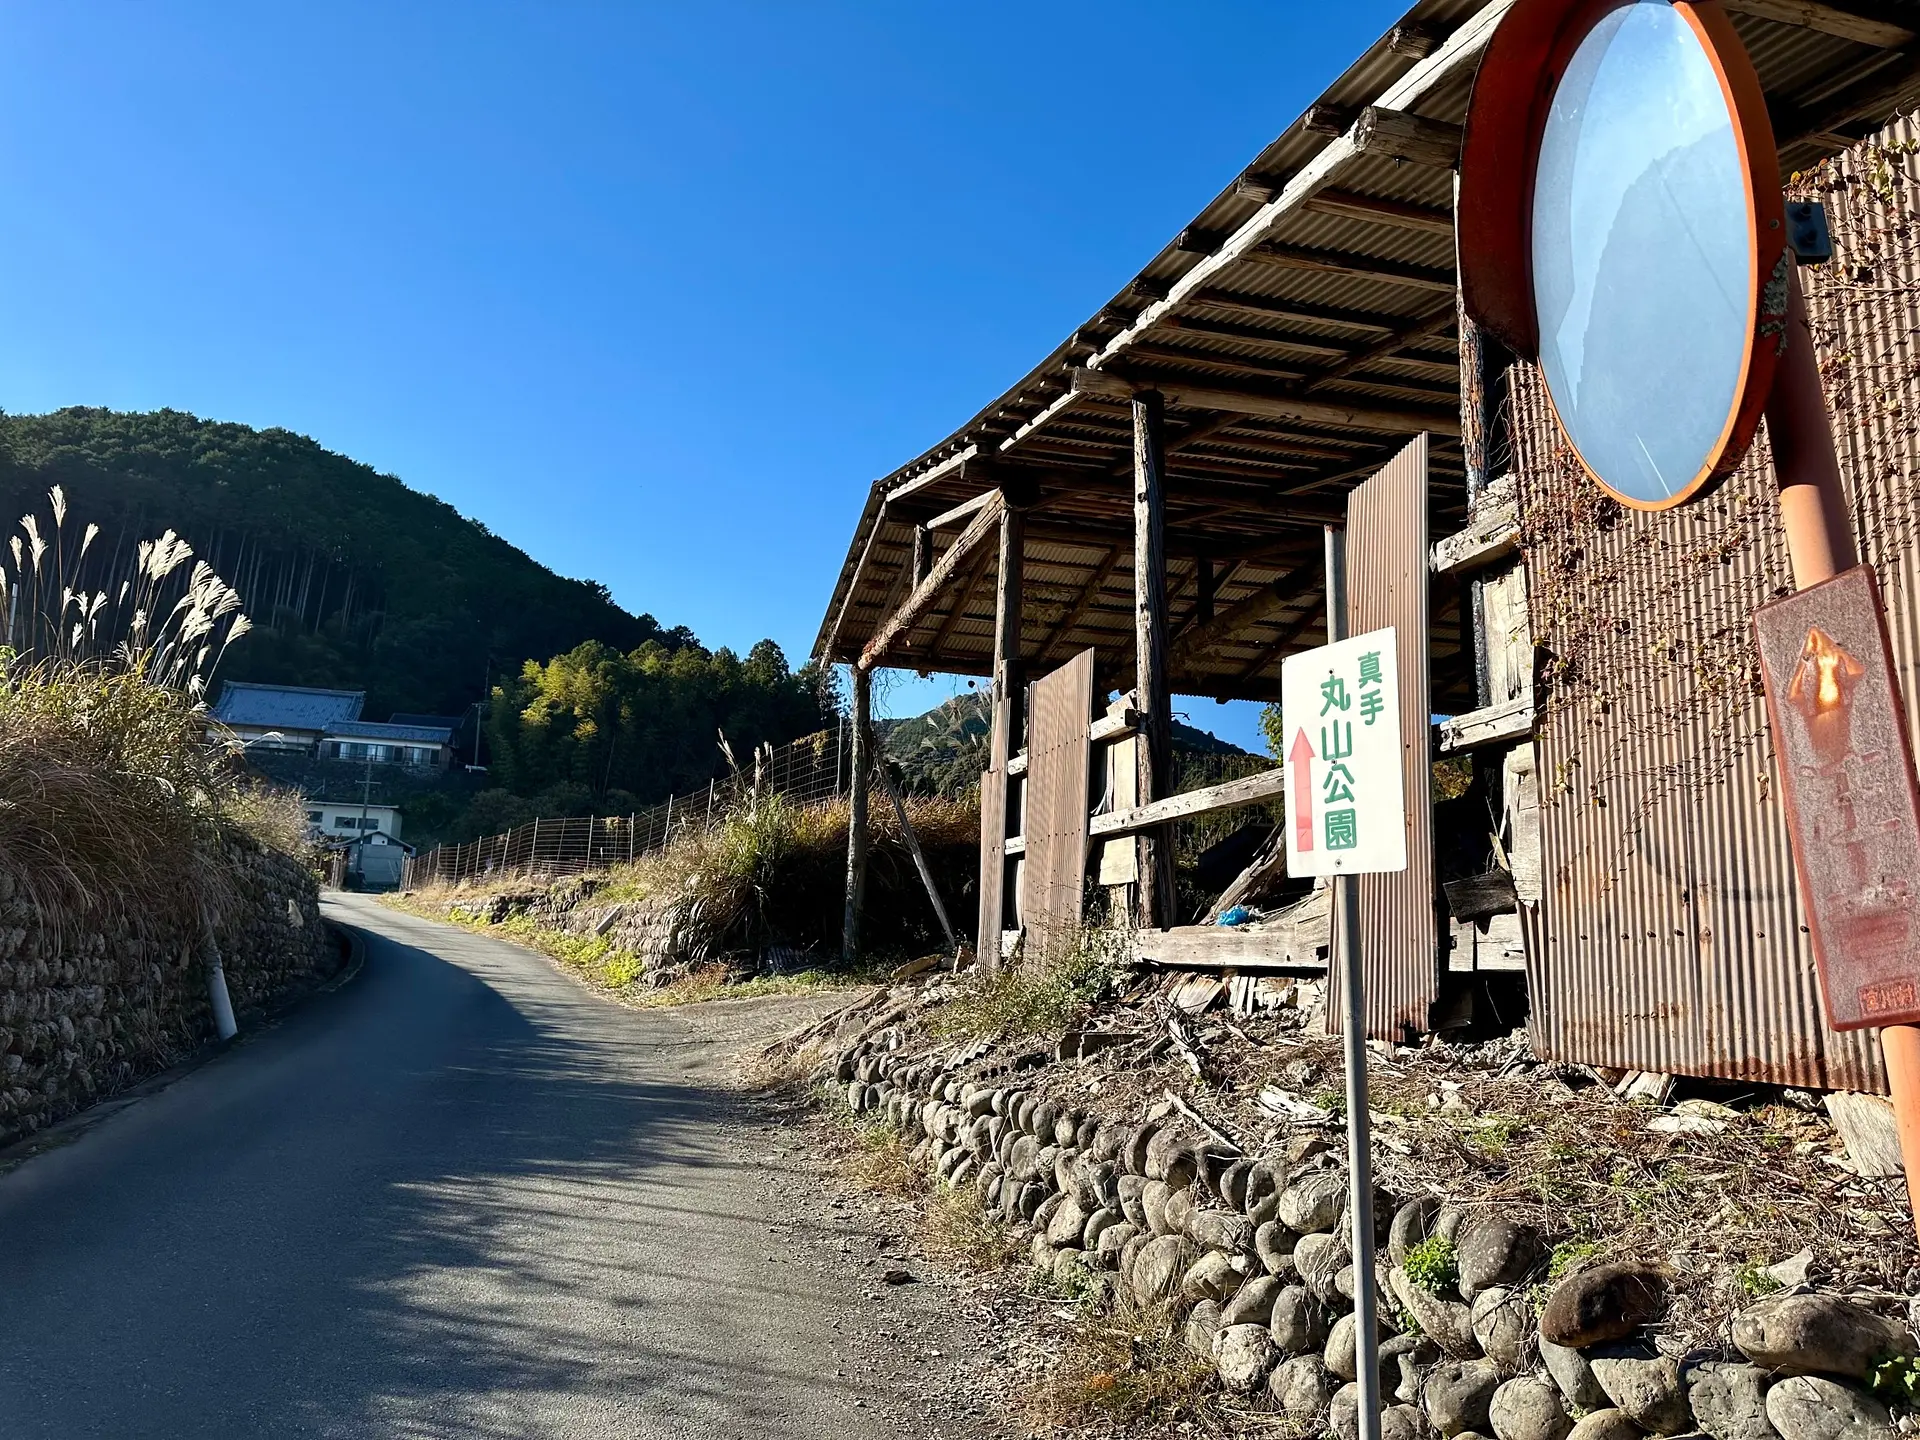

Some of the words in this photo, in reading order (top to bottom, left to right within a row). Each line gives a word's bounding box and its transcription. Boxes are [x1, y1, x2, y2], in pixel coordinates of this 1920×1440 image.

[1357, 650, 1384, 726] 真手
[1320, 675, 1357, 850] 丸山公園
